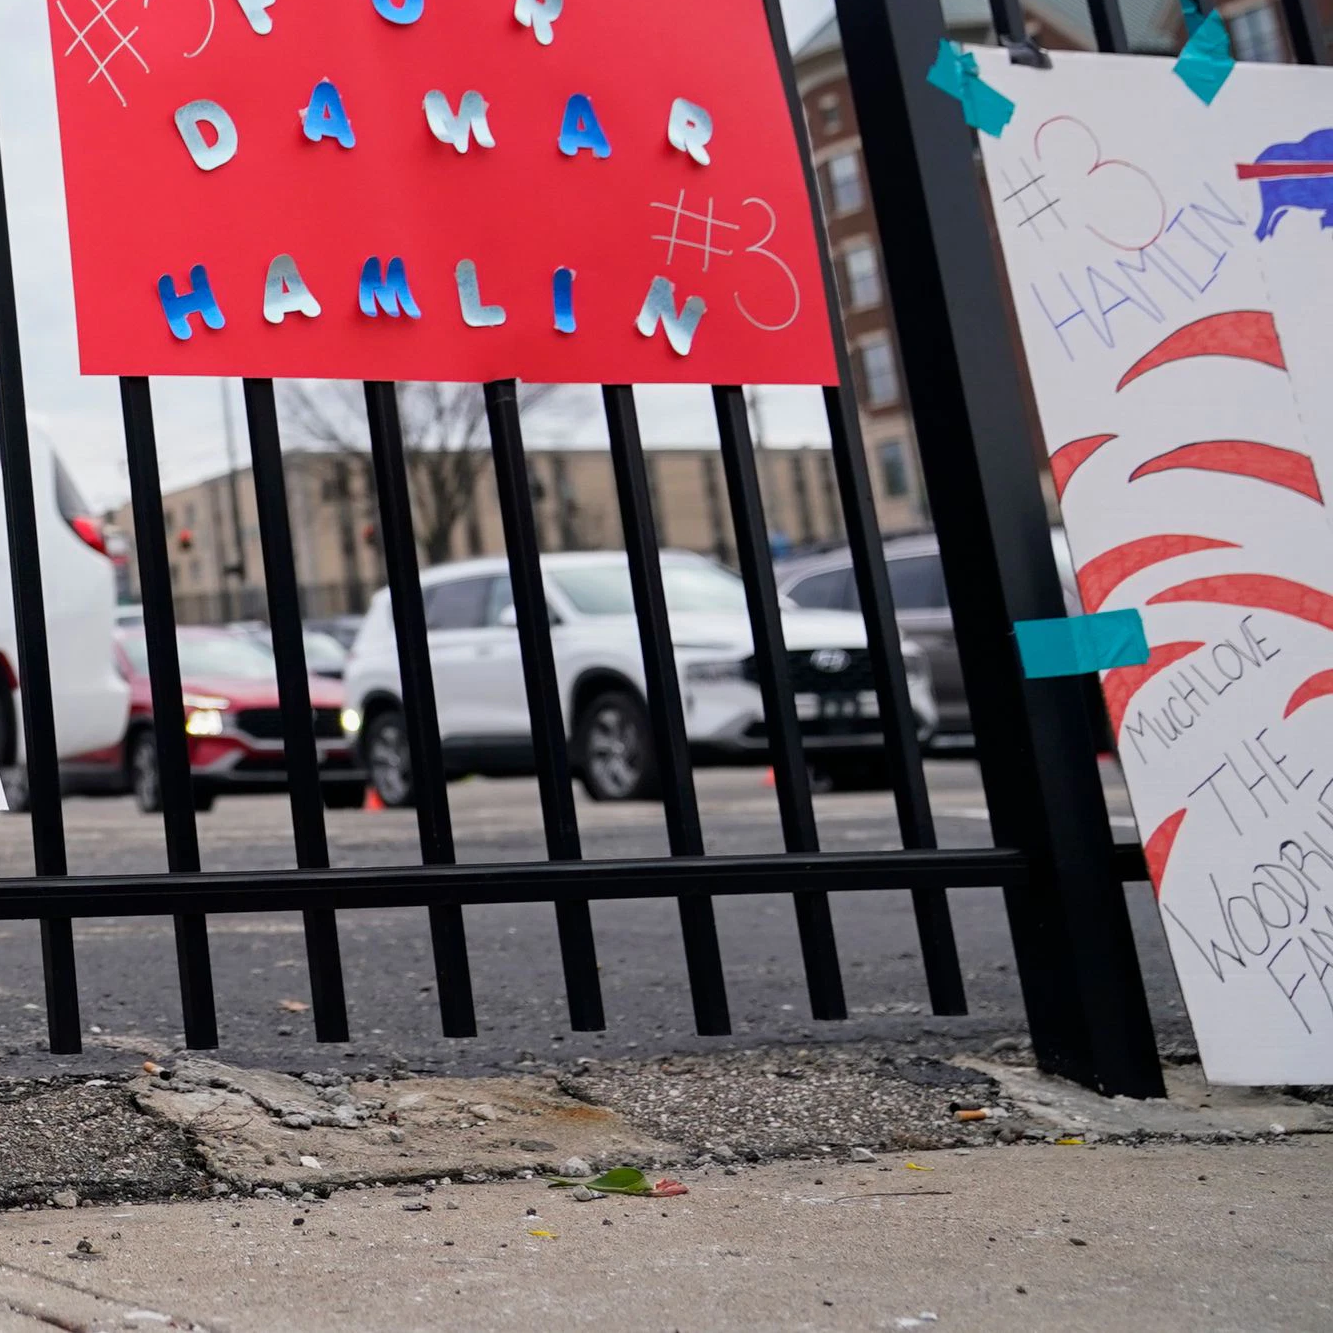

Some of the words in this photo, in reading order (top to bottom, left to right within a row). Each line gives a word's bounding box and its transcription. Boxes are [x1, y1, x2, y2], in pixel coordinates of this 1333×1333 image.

[173, 76, 715, 172] DAMAR
[1000, 114, 1167, 251] #3
[156, 253, 708, 357] HAMLIN
[649, 188, 802, 332] #3
[1030, 180, 1247, 363] HAMLIN
[1187, 727, 1315, 837] THE
